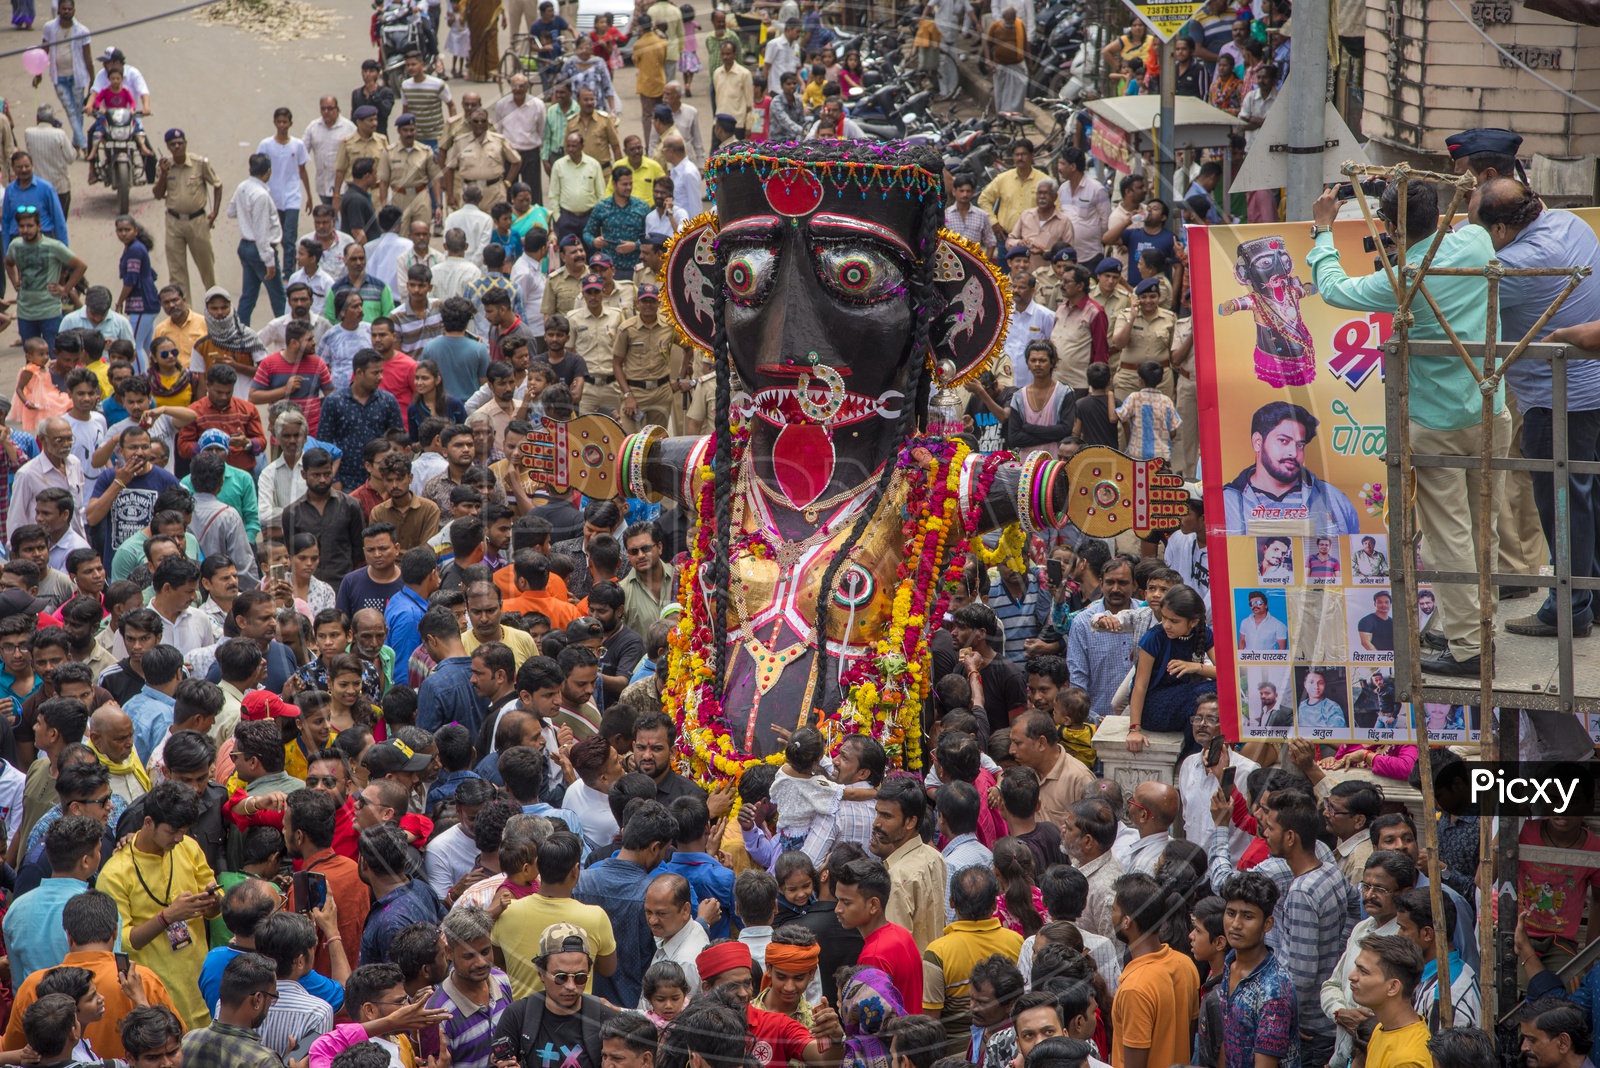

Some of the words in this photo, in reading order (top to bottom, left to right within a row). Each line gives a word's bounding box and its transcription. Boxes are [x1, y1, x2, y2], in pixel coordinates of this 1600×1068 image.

[1147, 5, 1193, 15] 7387673773
[1252, 504, 1282, 519] गौरव
[1284, 504, 1308, 519] हरडे
[1240, 650, 1261, 660] अमोल
[1262, 653, 1287, 661] पारटकर
[1353, 651, 1375, 661] विशाल
[1250, 727, 1274, 737] कमलेश
[1312, 729, 1333, 740] अतुल
[1441, 733, 1458, 741] भगत
